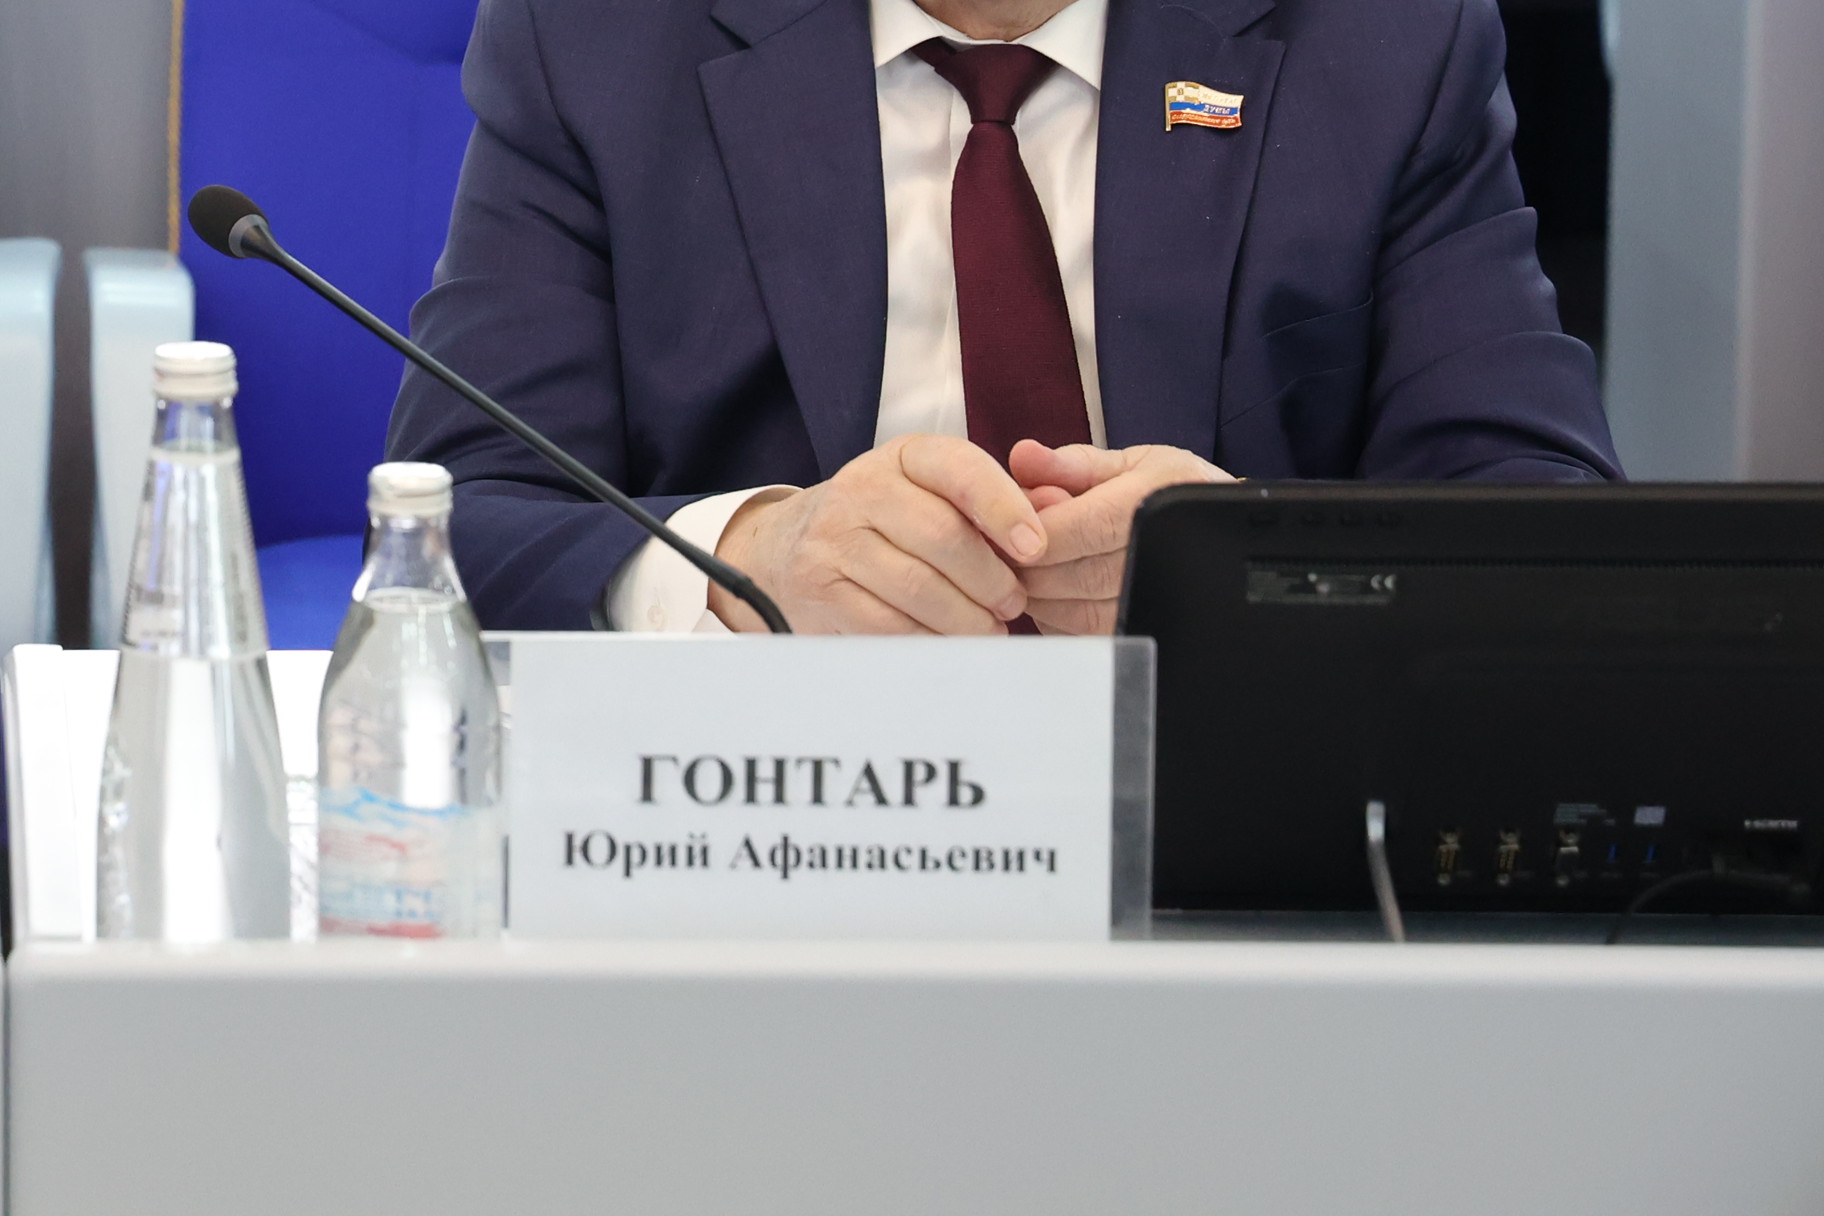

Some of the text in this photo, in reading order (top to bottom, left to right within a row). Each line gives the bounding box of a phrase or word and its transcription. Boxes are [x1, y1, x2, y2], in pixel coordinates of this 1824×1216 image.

[637, 754, 987, 808] ГОНТАРЬ
[563, 831, 1057, 880] Юрий Афанасьевич
